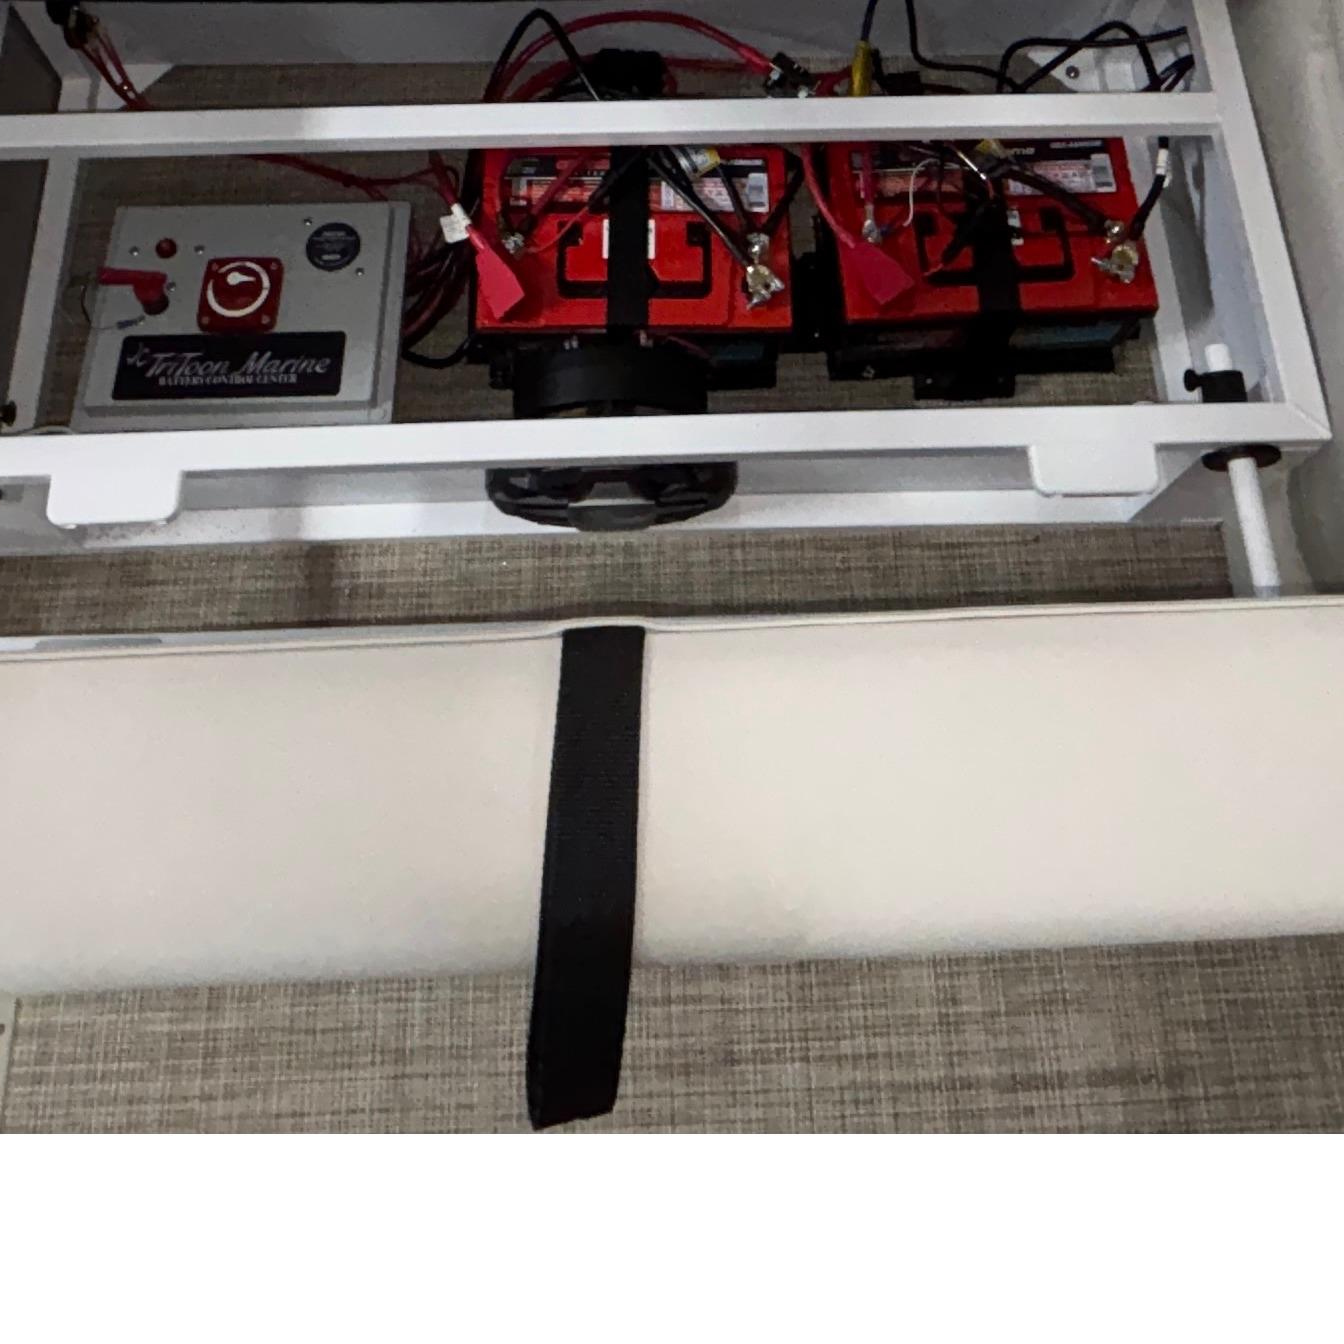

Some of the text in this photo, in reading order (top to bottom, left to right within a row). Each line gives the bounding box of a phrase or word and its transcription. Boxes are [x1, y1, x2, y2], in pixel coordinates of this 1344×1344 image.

[145, 351, 331, 378] TriToon Marine
[256, 373, 298, 384] CENTER
